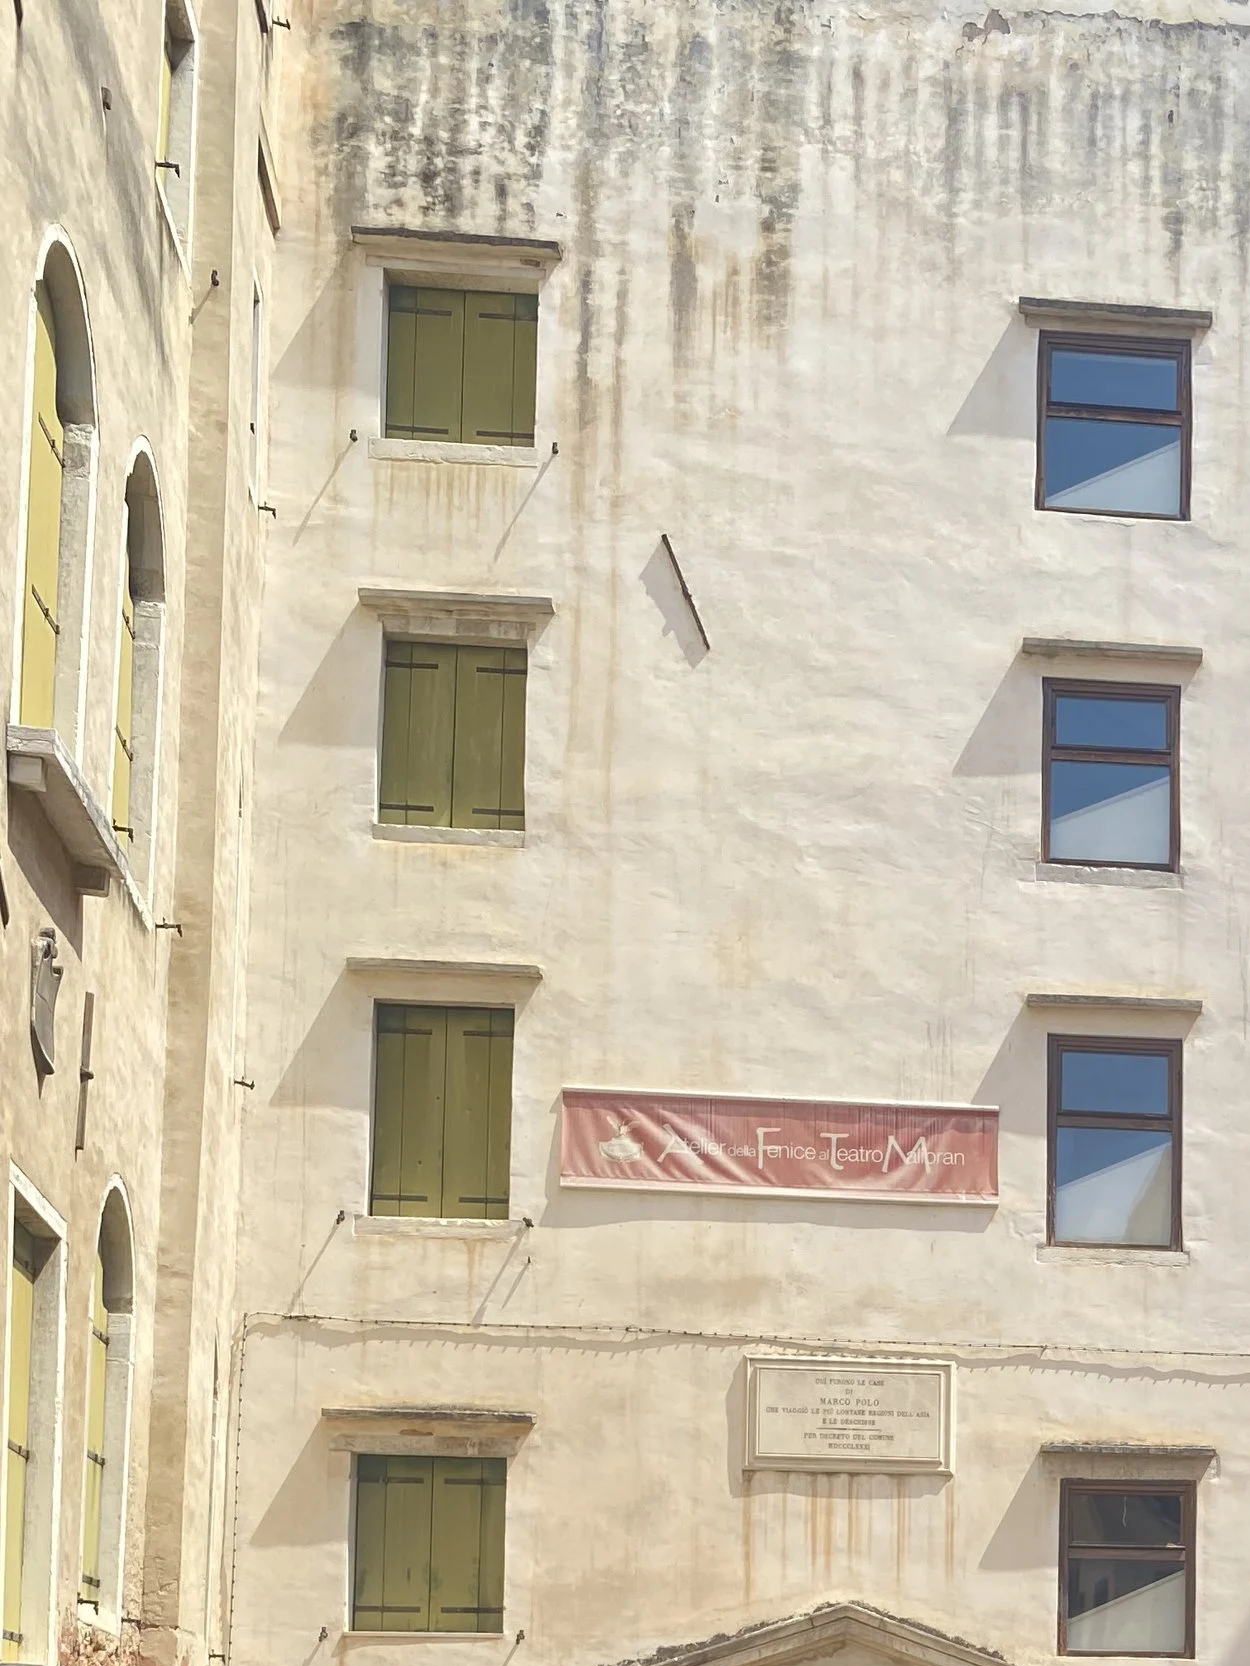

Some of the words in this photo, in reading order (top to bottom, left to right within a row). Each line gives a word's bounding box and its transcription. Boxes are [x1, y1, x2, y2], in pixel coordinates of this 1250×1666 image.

[657, 1123, 727, 1165] Atelier
[728, 1144, 756, 1157] della
[756, 1127, 816, 1169] Fenice
[818, 1148, 830, 1161] al
[820, 1132, 884, 1170] Teatro
[820, 1397, 851, 1406] MARCO
[855, 1398, 880, 1407] POLO
